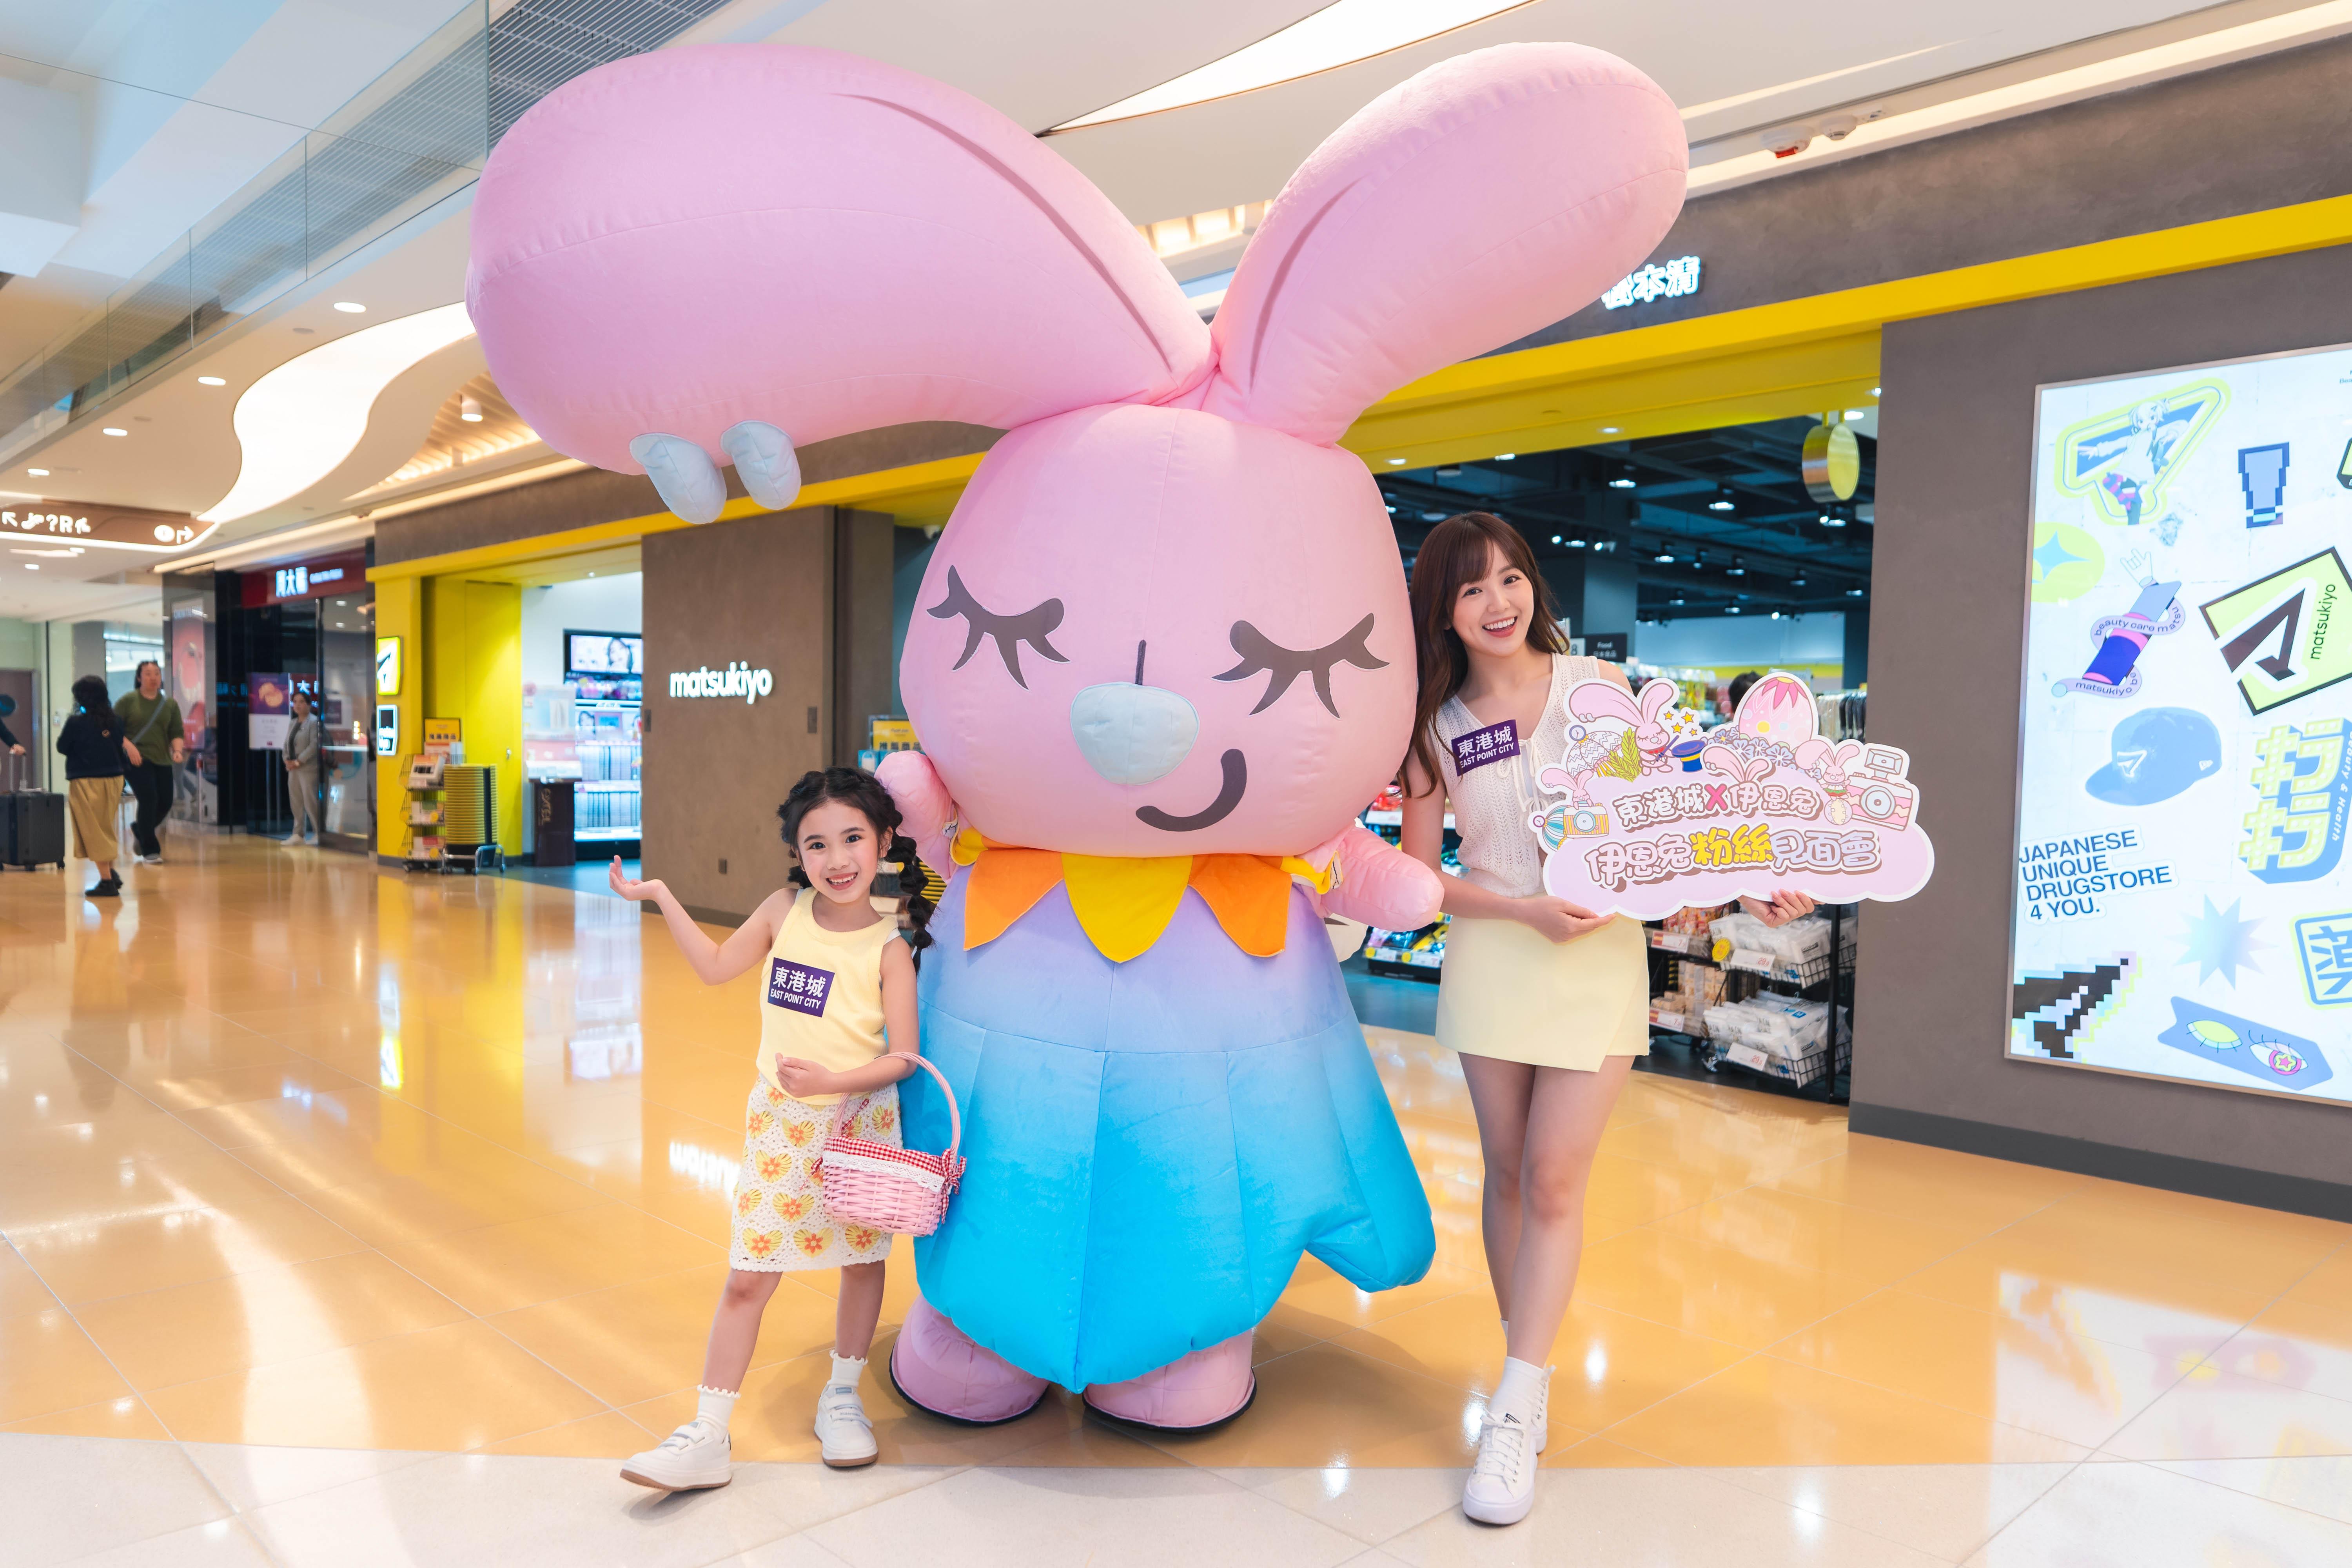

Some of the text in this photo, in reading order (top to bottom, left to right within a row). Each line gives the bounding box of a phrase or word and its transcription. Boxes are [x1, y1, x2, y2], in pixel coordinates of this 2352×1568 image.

[2094, 619, 2129, 636] beauty
[2131, 622, 2155, 632] care
[2310, 584, 2337, 659] matsukiyo
[670, 661, 773, 704] matsukiyo
[2076, 682, 2132, 696] matsukiyo
[1457, 726, 1513, 758] 東港城
[1460, 742, 1514, 768] EAST POINT CITY
[2332, 796, 2346, 842] Health
[2019, 830, 2138, 863] JAPANESE
[2022, 855, 2109, 882] UNIQUE
[2026, 866, 2172, 901] DRUGSTORE
[2031, 897, 2100, 920] 4 YOU.
[773, 967, 826, 998] 東港城
[770, 989, 822, 1009] EAST POINT CITY
